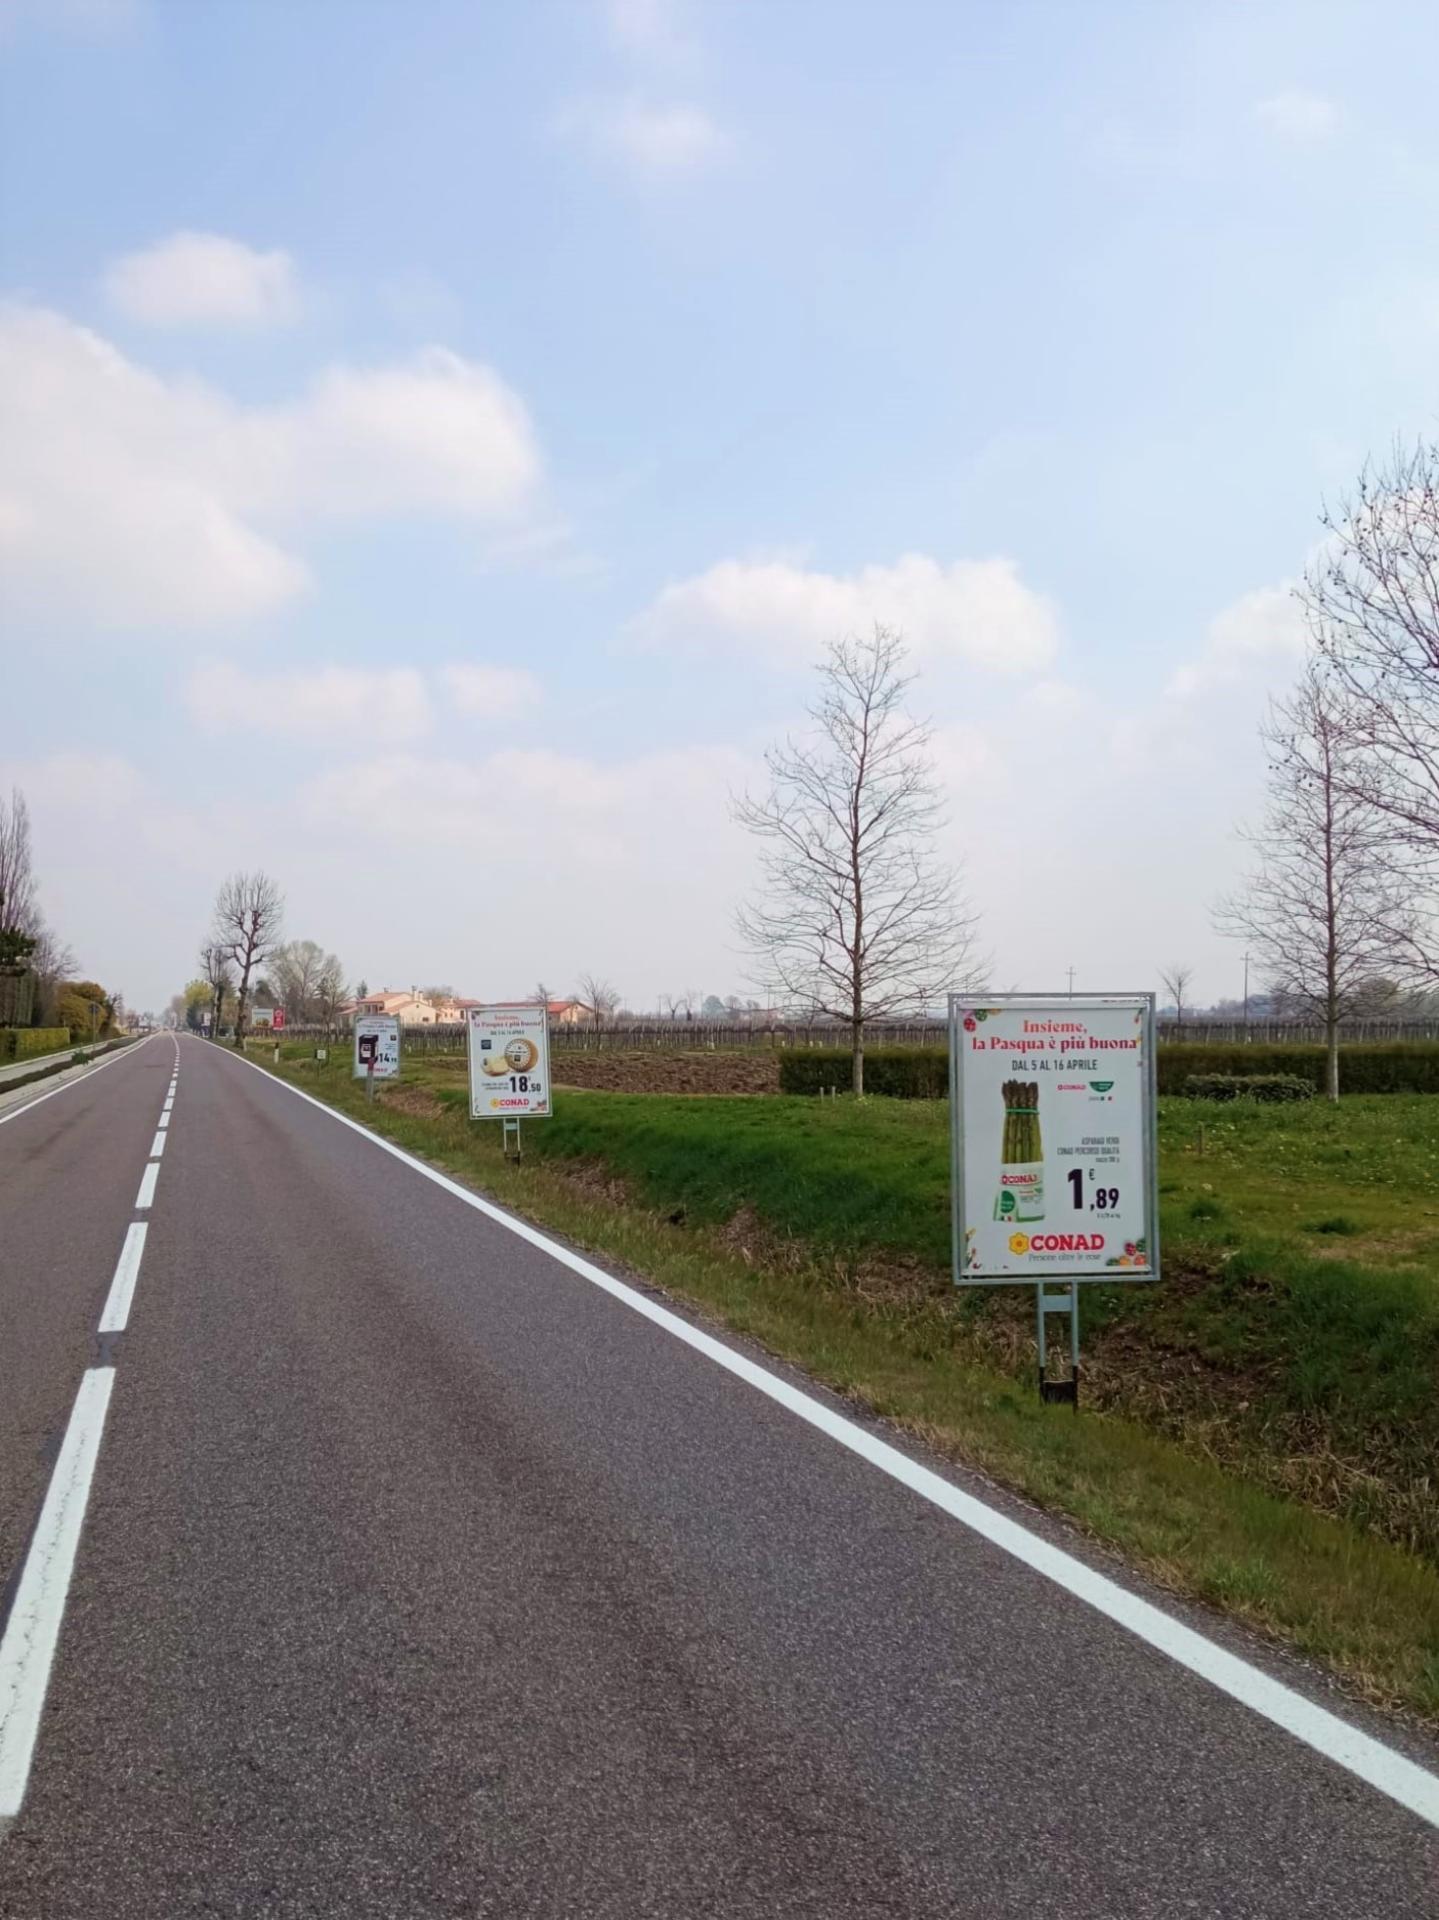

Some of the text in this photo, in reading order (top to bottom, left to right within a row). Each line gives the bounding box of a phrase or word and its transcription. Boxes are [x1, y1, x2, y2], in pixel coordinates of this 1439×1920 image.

[1023, 1019, 1088, 1034] Insieme,
[972, 1035, 1137, 1054] la Pasqua è più buona
[1011, 1058, 1098, 1072] DAL 5 AL 16 APRILE
[499, 1098, 529, 1106] CONAD
[1030, 1233, 1105, 1251] CONAD
